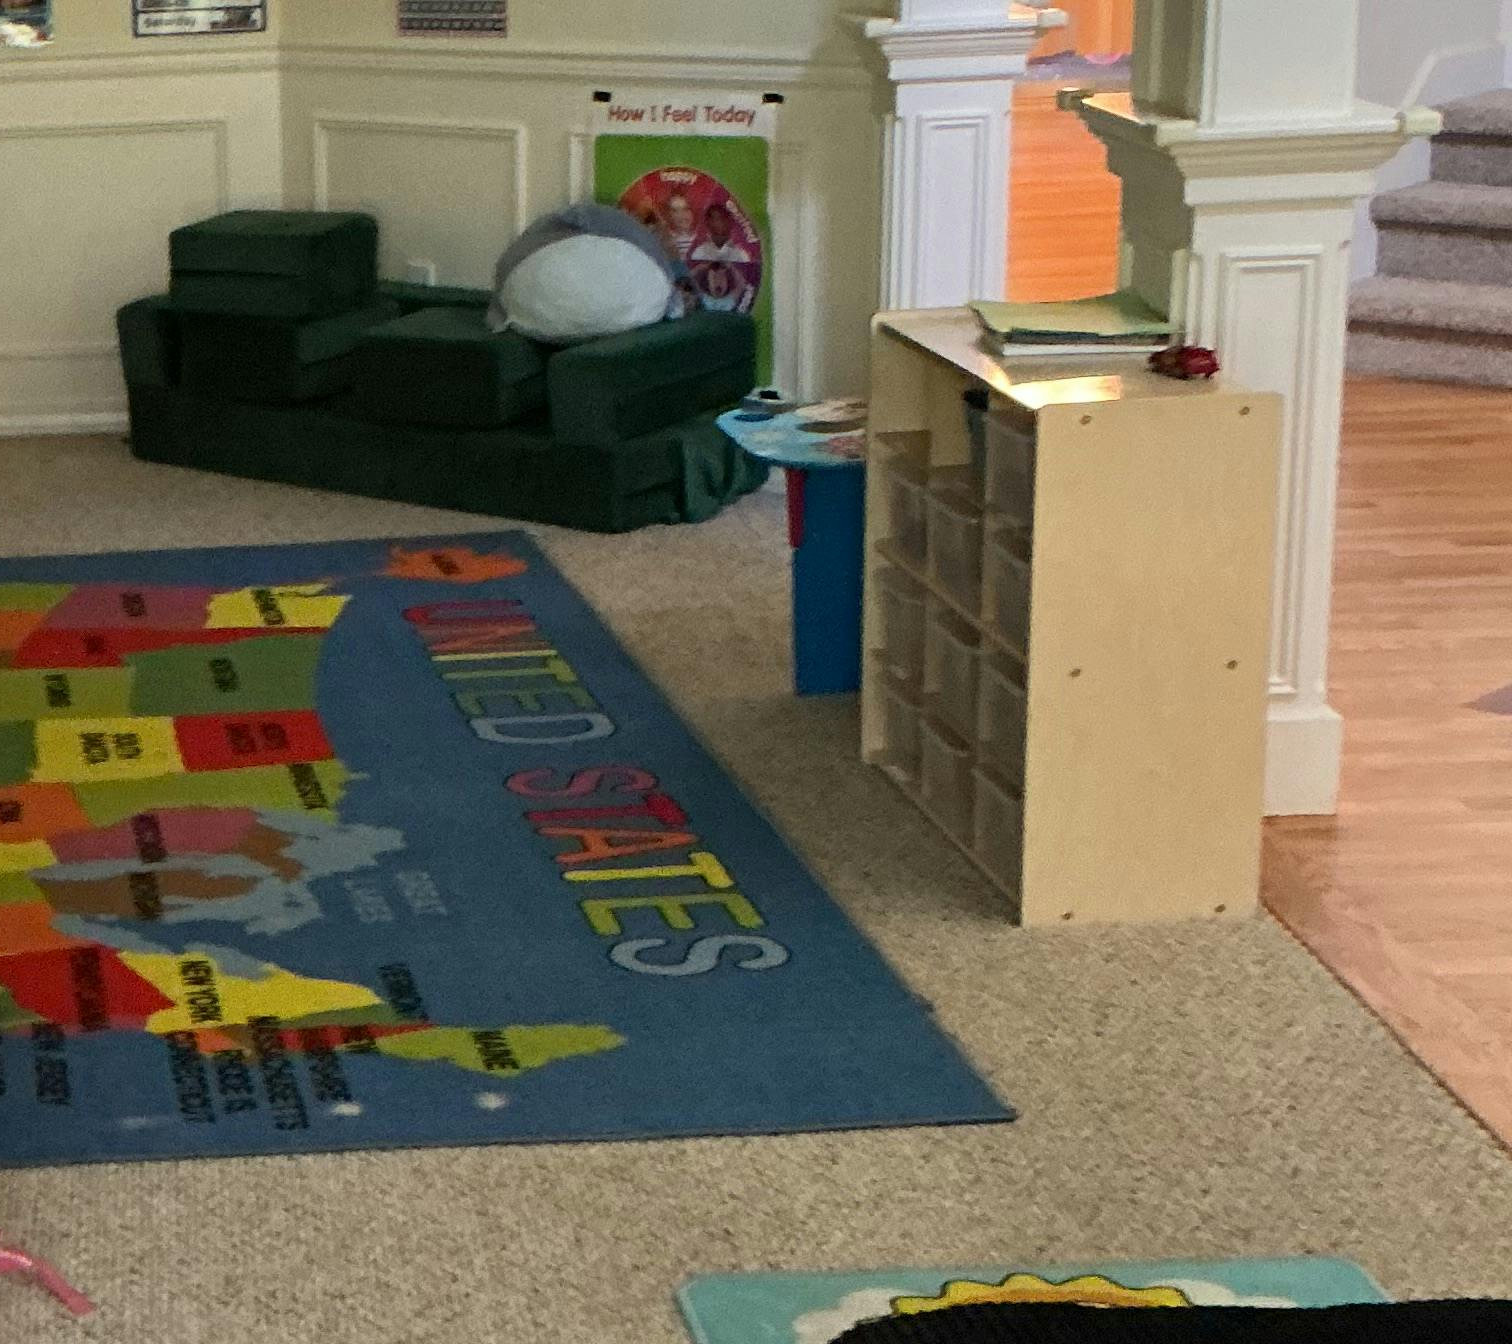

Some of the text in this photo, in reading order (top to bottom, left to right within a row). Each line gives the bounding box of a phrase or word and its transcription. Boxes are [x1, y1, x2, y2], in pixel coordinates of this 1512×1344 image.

[607, 105, 757, 128] How I Feel Today
[402, 598, 791, 977] UNITED STATES
[179, 960, 223, 1025] NEW YORK
[471, 1030, 520, 1071] MAINE
